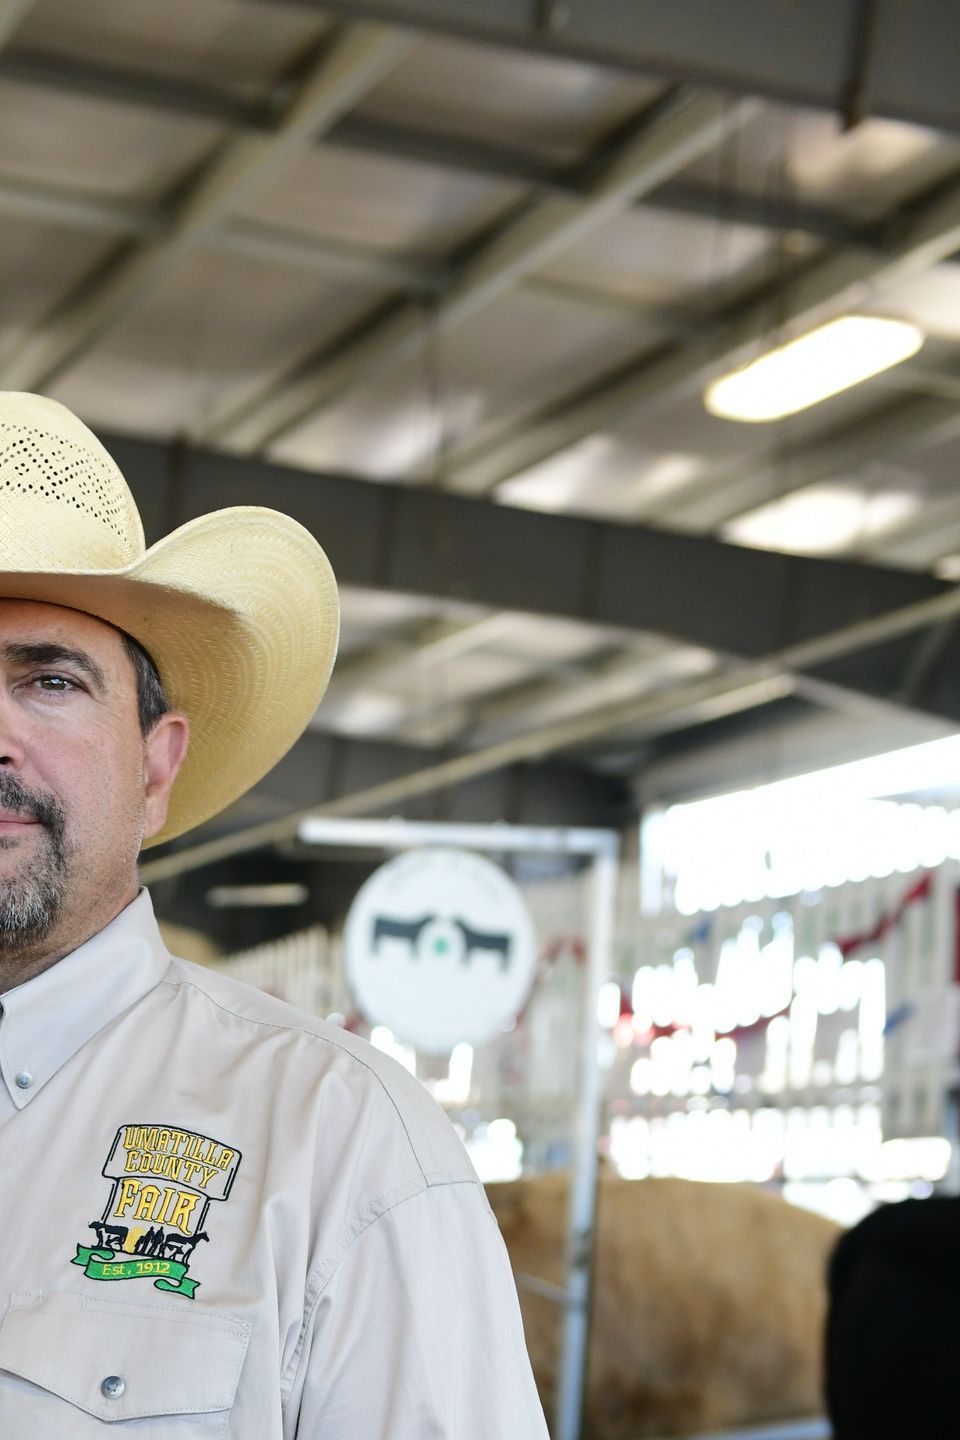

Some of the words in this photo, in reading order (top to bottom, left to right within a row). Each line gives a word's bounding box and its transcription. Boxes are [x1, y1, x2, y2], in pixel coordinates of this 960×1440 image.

[123, 1126, 235, 1171] UMATILLA
[124, 1151, 218, 1189] COUNTY
[113, 1178, 201, 1236] FAIR
[136, 1261, 171, 1275] 1912
